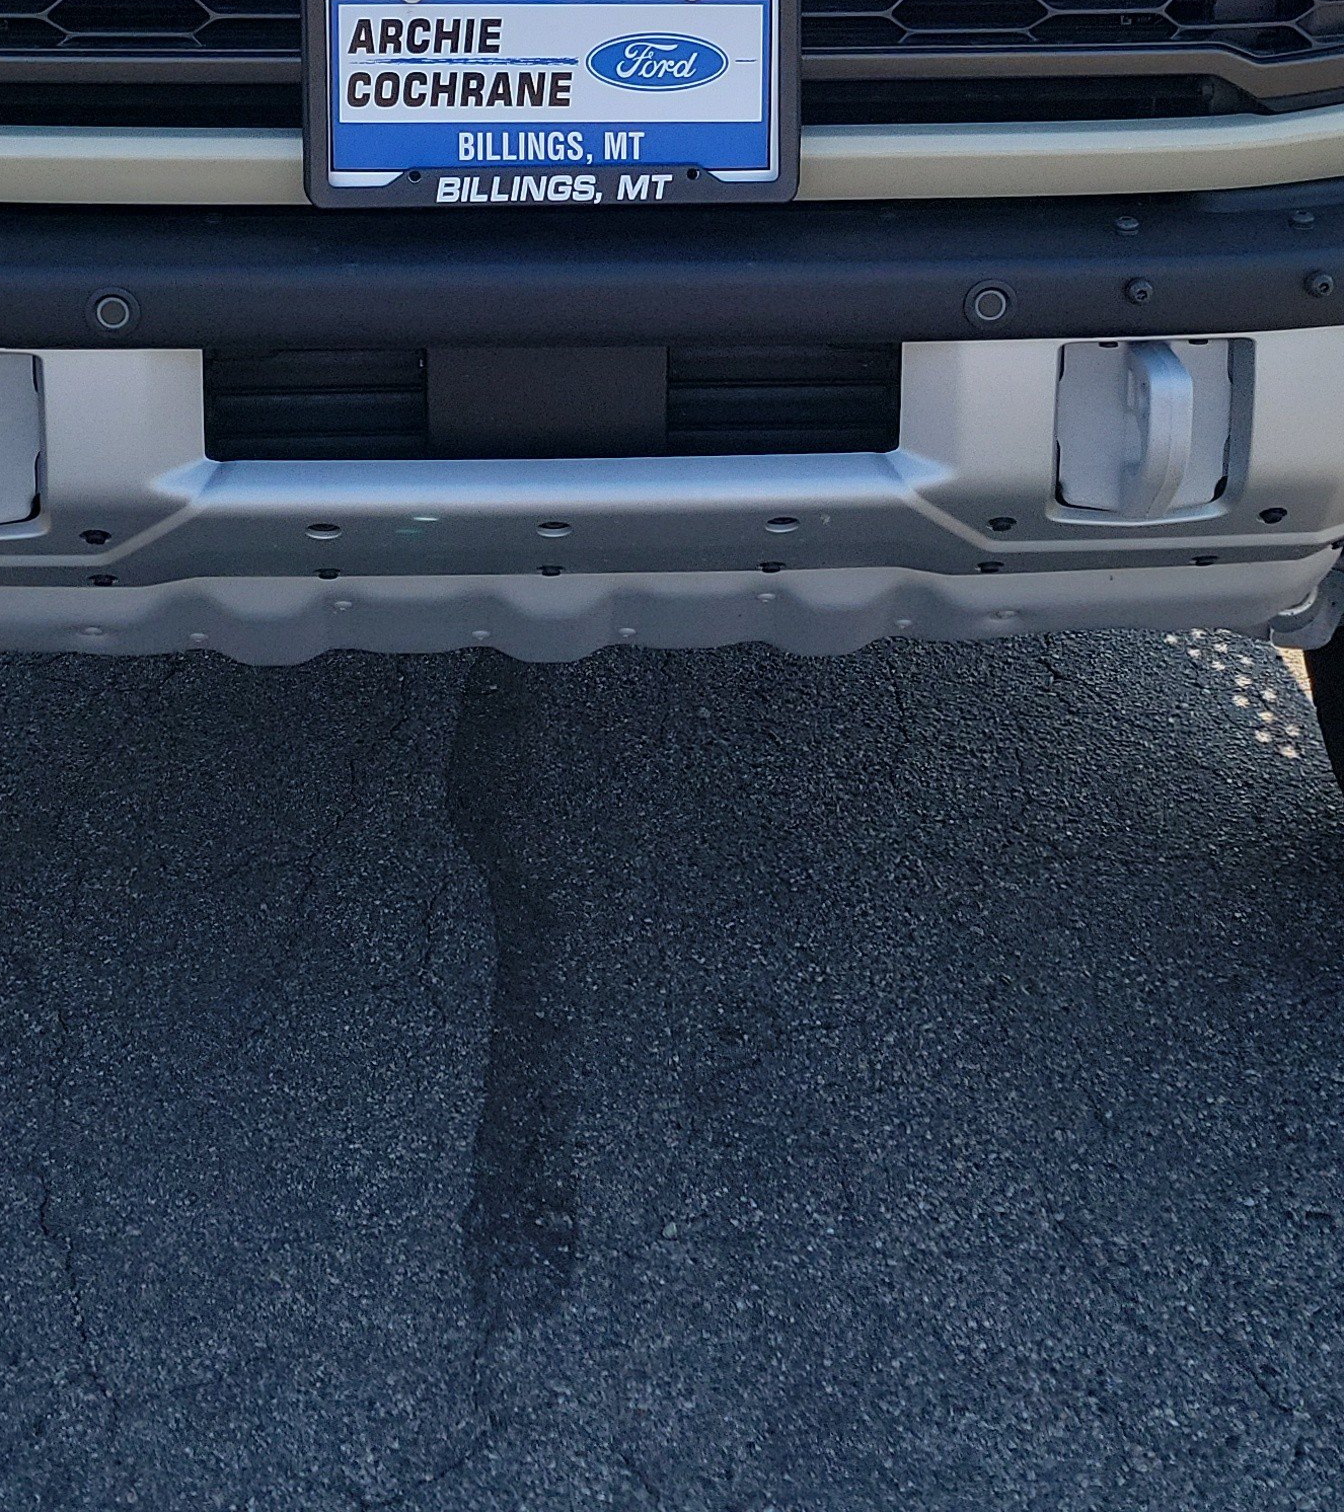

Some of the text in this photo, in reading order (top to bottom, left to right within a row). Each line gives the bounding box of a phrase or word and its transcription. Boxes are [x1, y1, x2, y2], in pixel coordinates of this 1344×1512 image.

[347, 18, 503, 55] ARCHIE
[616, 42, 698, 80] Ford
[346, 71, 573, 108] COCHRANE
[458, 131, 646, 165] BILLINGS, MT
[436, 174, 673, 204] BILLINGS, MT
